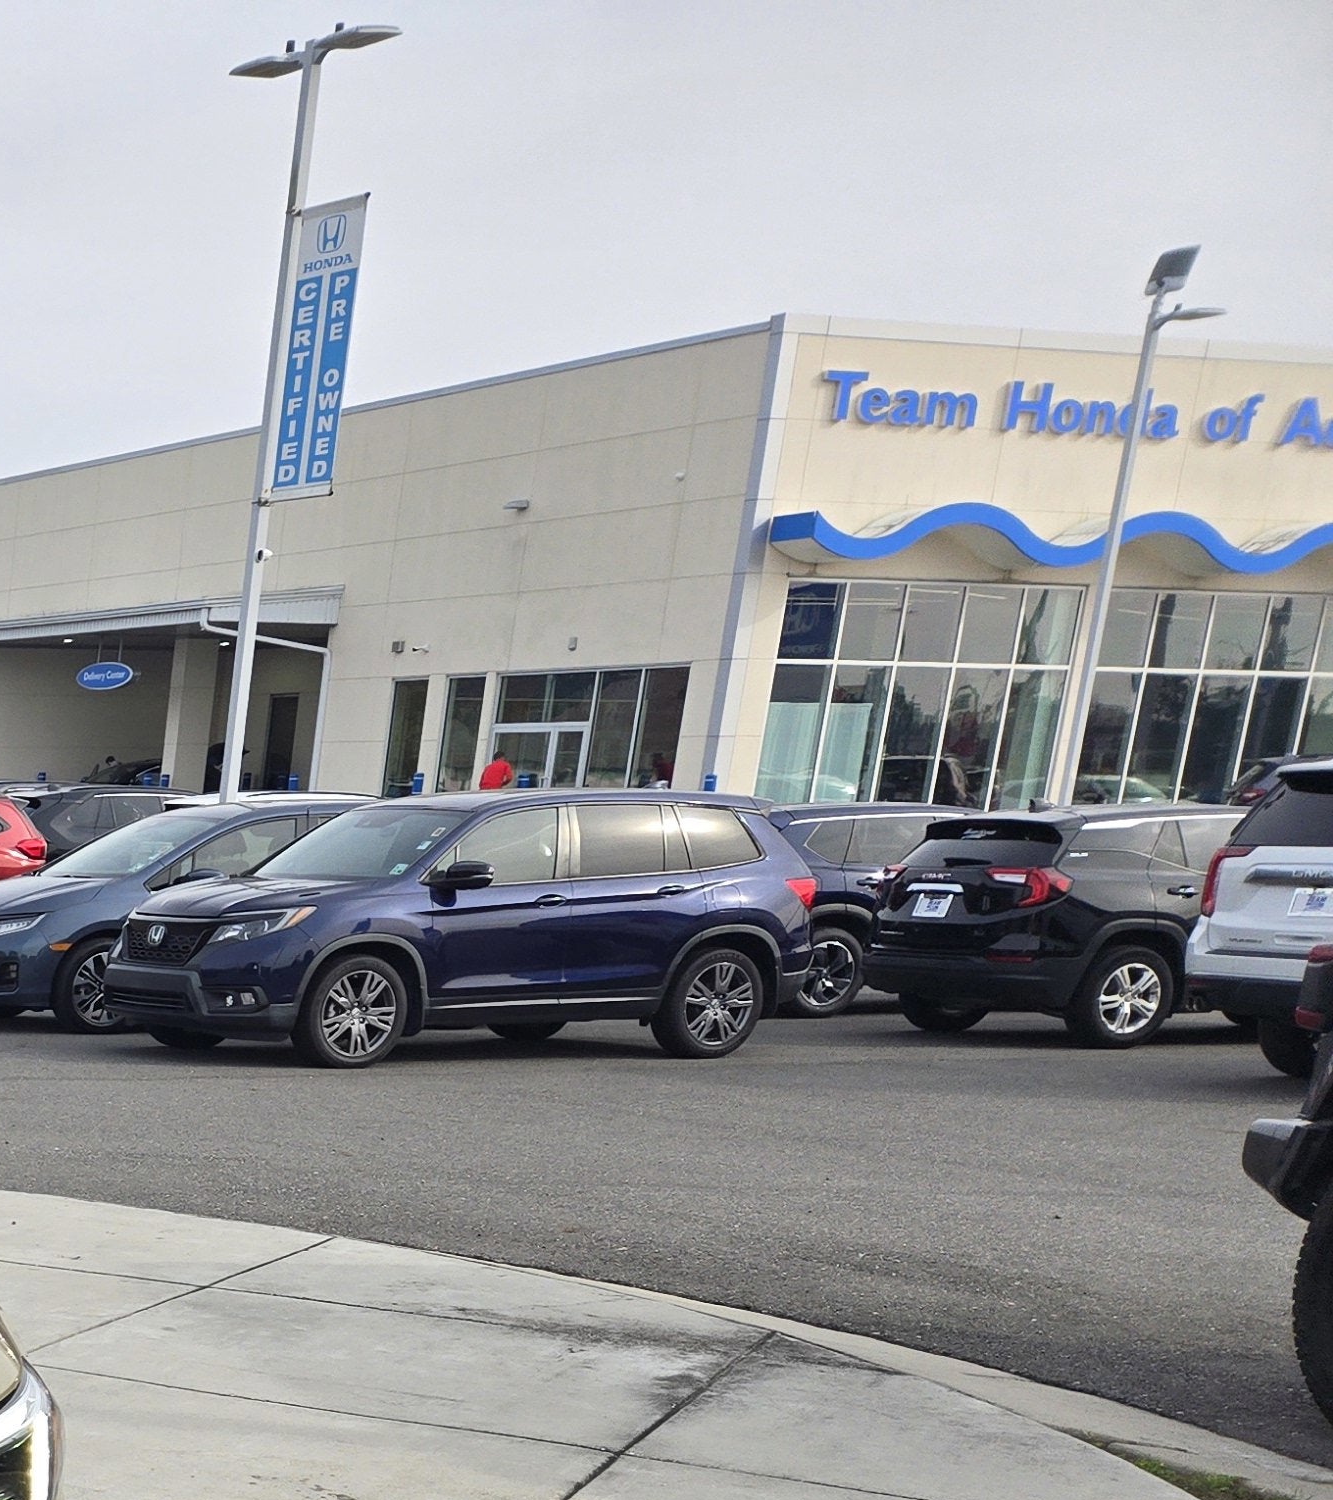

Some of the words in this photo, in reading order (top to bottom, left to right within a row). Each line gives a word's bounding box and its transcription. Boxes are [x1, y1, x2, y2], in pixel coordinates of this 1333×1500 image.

[303, 254, 353, 274] HONDA
[329, 273, 350, 342] PRE
[277, 281, 318, 483] CERTIFIED
[823, 370, 978, 429] Team
[1003, 380, 1180, 441] Honda
[1204, 393, 1266, 443] of
[311, 368, 341, 479] OWNED
[83, 671, 106, 682] Delivery
[106, 670, 126, 680] Center
